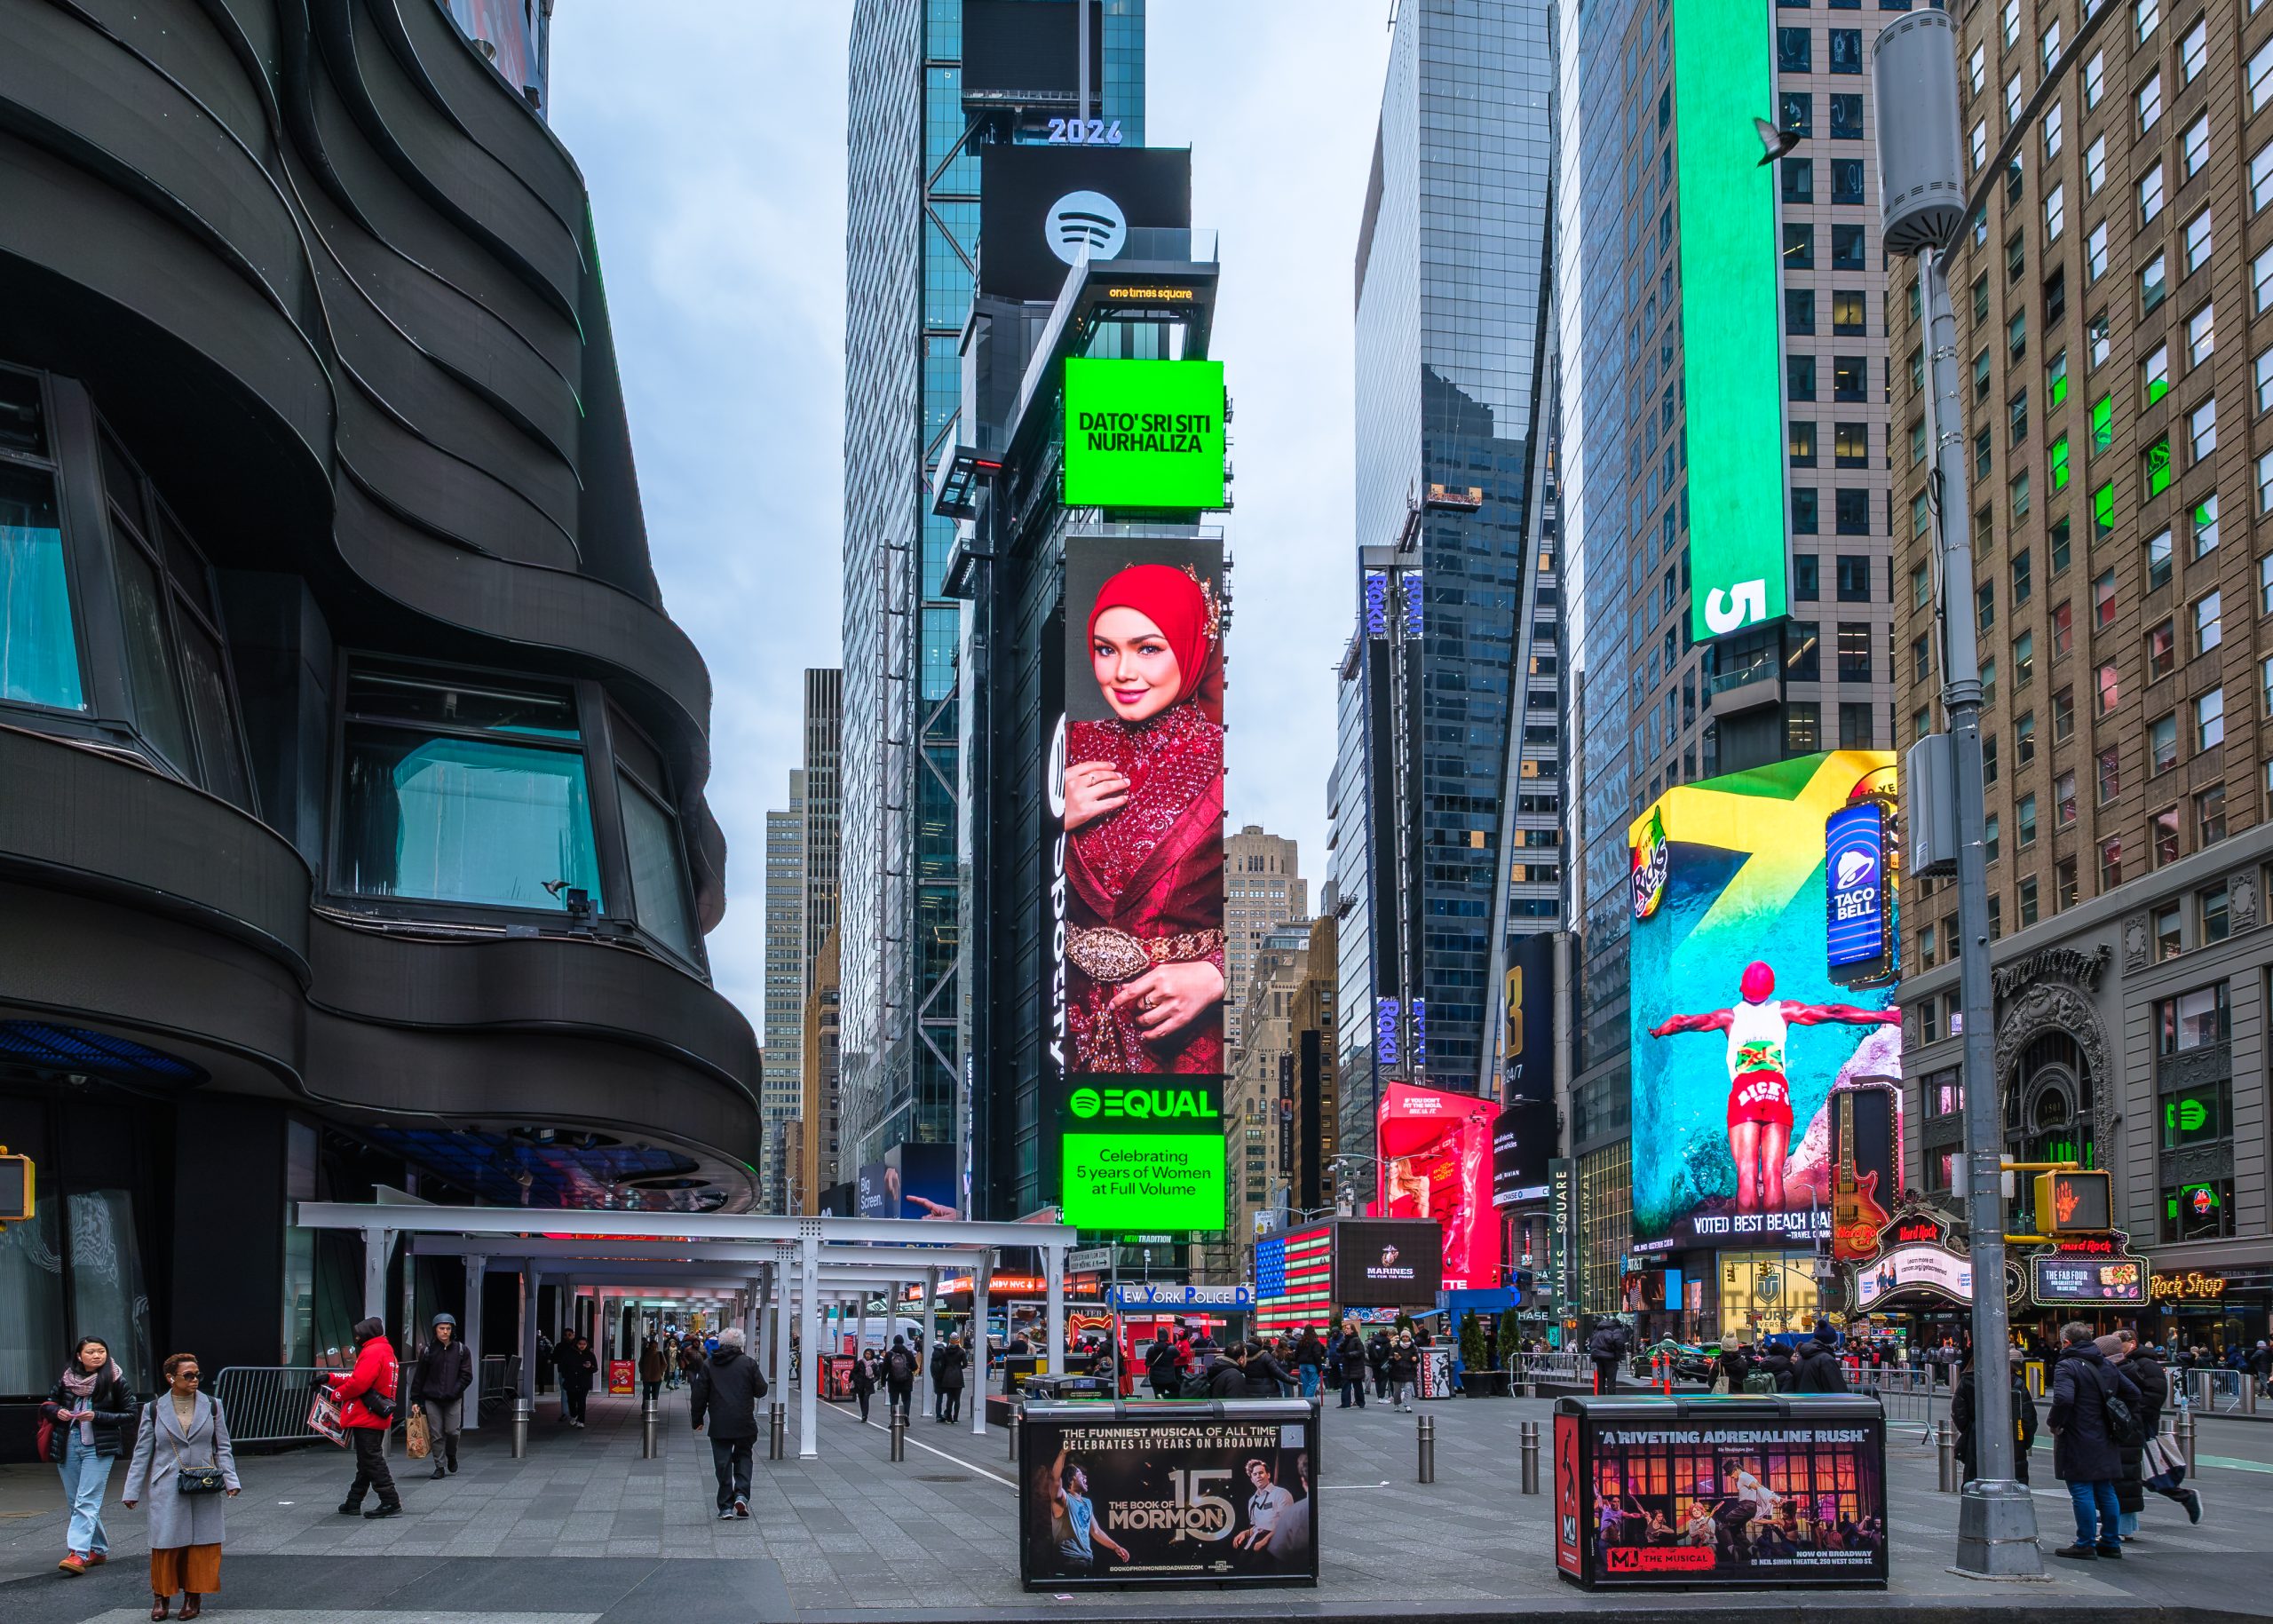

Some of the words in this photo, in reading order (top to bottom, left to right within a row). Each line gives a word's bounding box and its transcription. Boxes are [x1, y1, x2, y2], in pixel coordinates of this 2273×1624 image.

[1048, 118, 1123, 145] 2026
[1110, 289, 1129, 297] one
[1129, 288, 1157, 297] times
[1158, 289, 1192, 300] square
[1079, 412, 1138, 432] DATO'
[1141, 414, 1172, 432] SRI
[1176, 415, 1211, 433] SITI
[1088, 432, 1203, 454] NURHALIZA
[1367, 576, 1387, 633] ROKU
[1705, 578, 1766, 634] 5
[1834, 887, 1875, 907] TACO
[1837, 902, 1876, 921] BELL
[1378, 1002, 1399, 1064] ROKU
[1506, 1064, 1523, 1082] 24/7
[1105, 1089, 1218, 1119] EQUAL
[1099, 1149, 1188, 1166] Celebrating
[1076, 1165, 1087, 1178] 5
[1089, 1168, 1130, 1182] years
[1133, 1166, 1149, 1178] of
[1152, 1166, 1211, 1179] Women
[860, 1176, 871, 1194] Big
[1091, 1184, 1106, 1195] at
[1110, 1182, 1136, 1195] Full
[1139, 1182, 1196, 1196] Volume
[860, 1194, 883, 1209] Screen.
[1503, 1192, 1517, 1201] CHASE
[1556, 1171, 1567, 1233] SQUARE
[1694, 1216, 1730, 1233] VOTED
[1734, 1215, 1763, 1232] BEST
[1767, 1213, 1806, 1231] BEACH
[1837, 1226, 1861, 1239] Hard
[1863, 1226, 1877, 1240] Ro
[1899, 1225, 1918, 1240] Hard
[1919, 1224, 1937, 1241] Rock
[2087, 1240, 2111, 1253] Rock
[1628, 1257, 1643, 1271] AT&T
[2046, 1271, 2059, 1280] THE
[2059, 1271, 2071, 1280] FAB
[2071, 1271, 2087, 1280] FOUR
[1110, 1286, 1143, 1303] NEW
[1144, 1286, 1181, 1303] YORK
[1185, 1287, 1230, 1303] POLICE
[2150, 1275, 2184, 1299] Rock
[2185, 1272, 2224, 1297] Shop
[1059, 1429, 1085, 1438] "THE
[1089, 1428, 1148, 1438] FUNNIEST
[1151, 1427, 1203, 1437] MUSICAL
[1206, 1427, 1222, 1437] OF
[1225, 1427, 1247, 1436] ALL
[1249, 1426, 1279, 1436] TIME"
[1599, 1430, 1616, 1445] "A
[1619, 1430, 1700, 1444] RIVETING
[1702, 1430, 1812, 1444] ADRENALINE
[1815, 1429, 1869, 1443] RUSH."
[1063, 1438, 1135, 1451] CELEBRATES
[1138, 1438, 1151, 1449] 15
[1155, 1438, 1192, 1449] YEARS
[1196, 1438, 1211, 1448] ON
[1216, 1438, 1277, 1448] BROADWAY
[1130, 1501, 1160, 1509] BOOK
[1168, 1470, 1235, 1541] 15
[1109, 1509, 1224, 1530] MORMON
[1564, 1515, 1576, 1541] MJ
[1612, 1549, 1639, 1568] MJ
